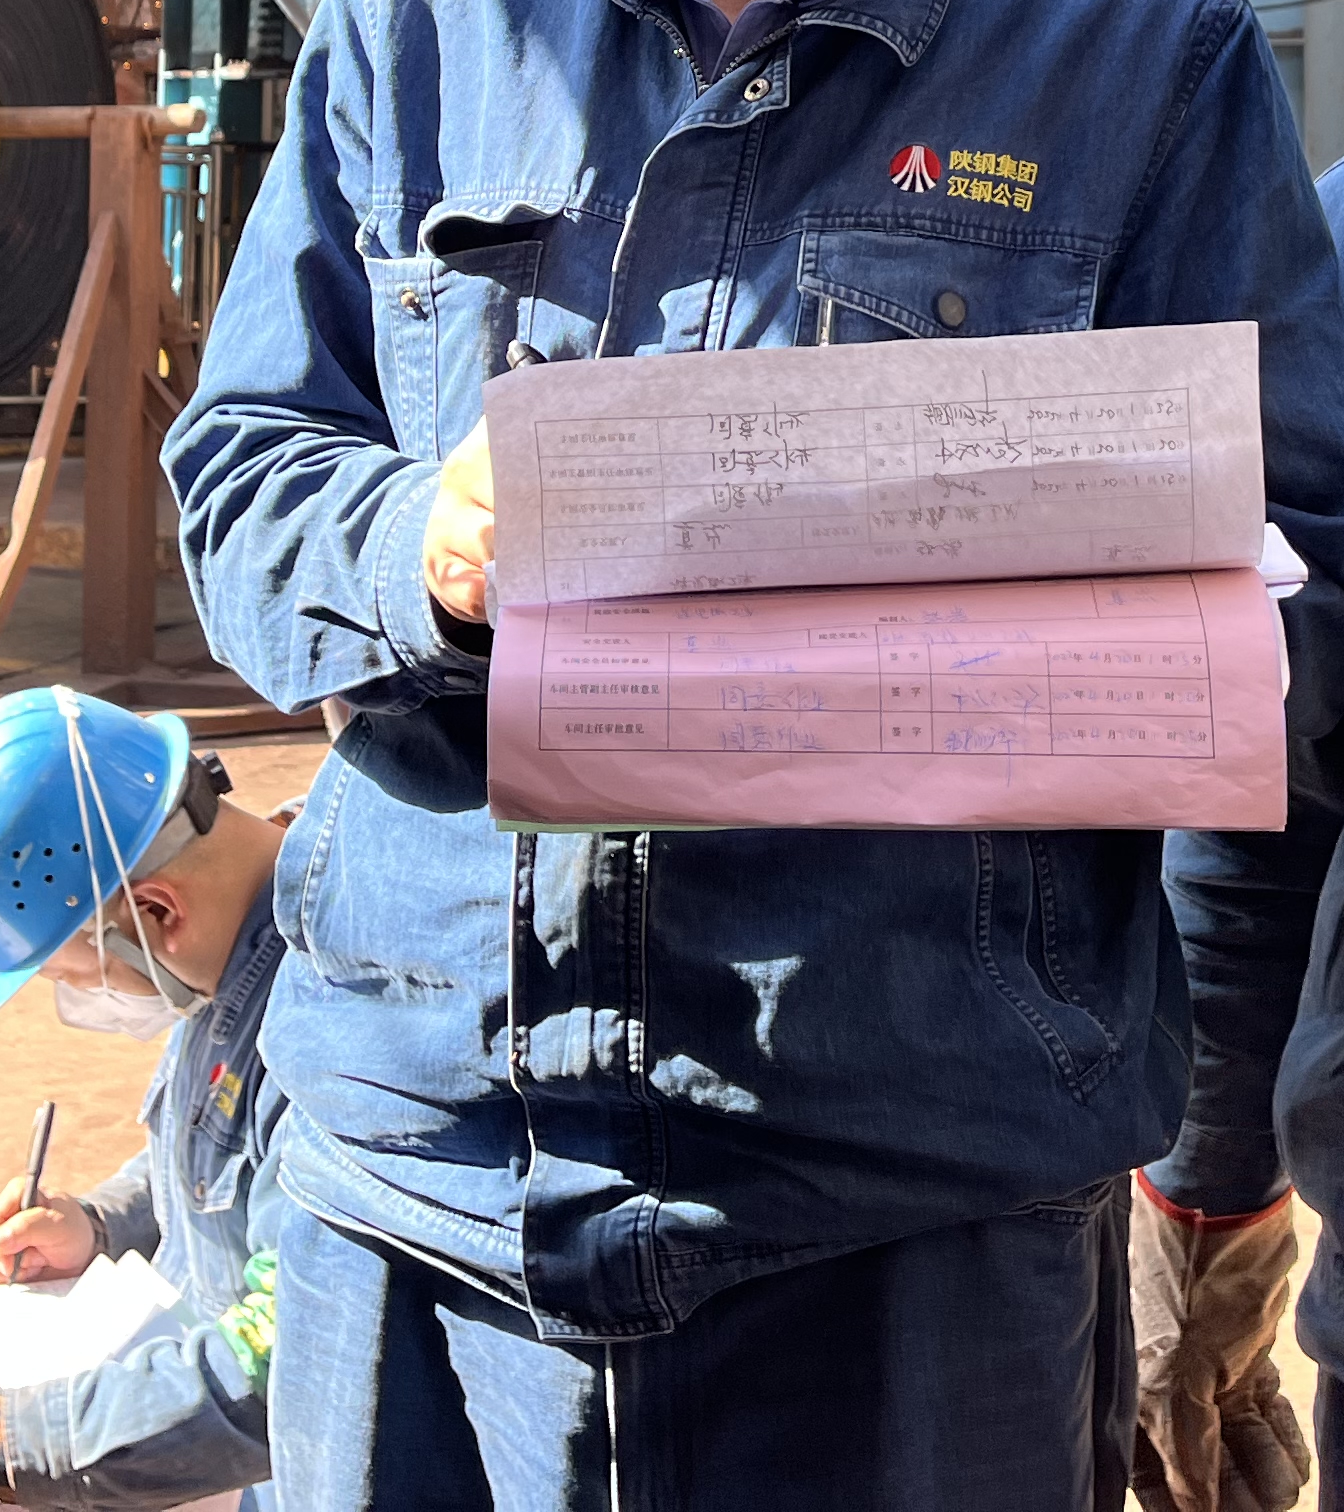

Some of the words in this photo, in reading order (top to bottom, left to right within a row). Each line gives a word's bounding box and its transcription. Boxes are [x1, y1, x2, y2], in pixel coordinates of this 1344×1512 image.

[948, 149, 1039, 186] 陕钢集团
[946, 175, 1034, 213] 汉钢公司
